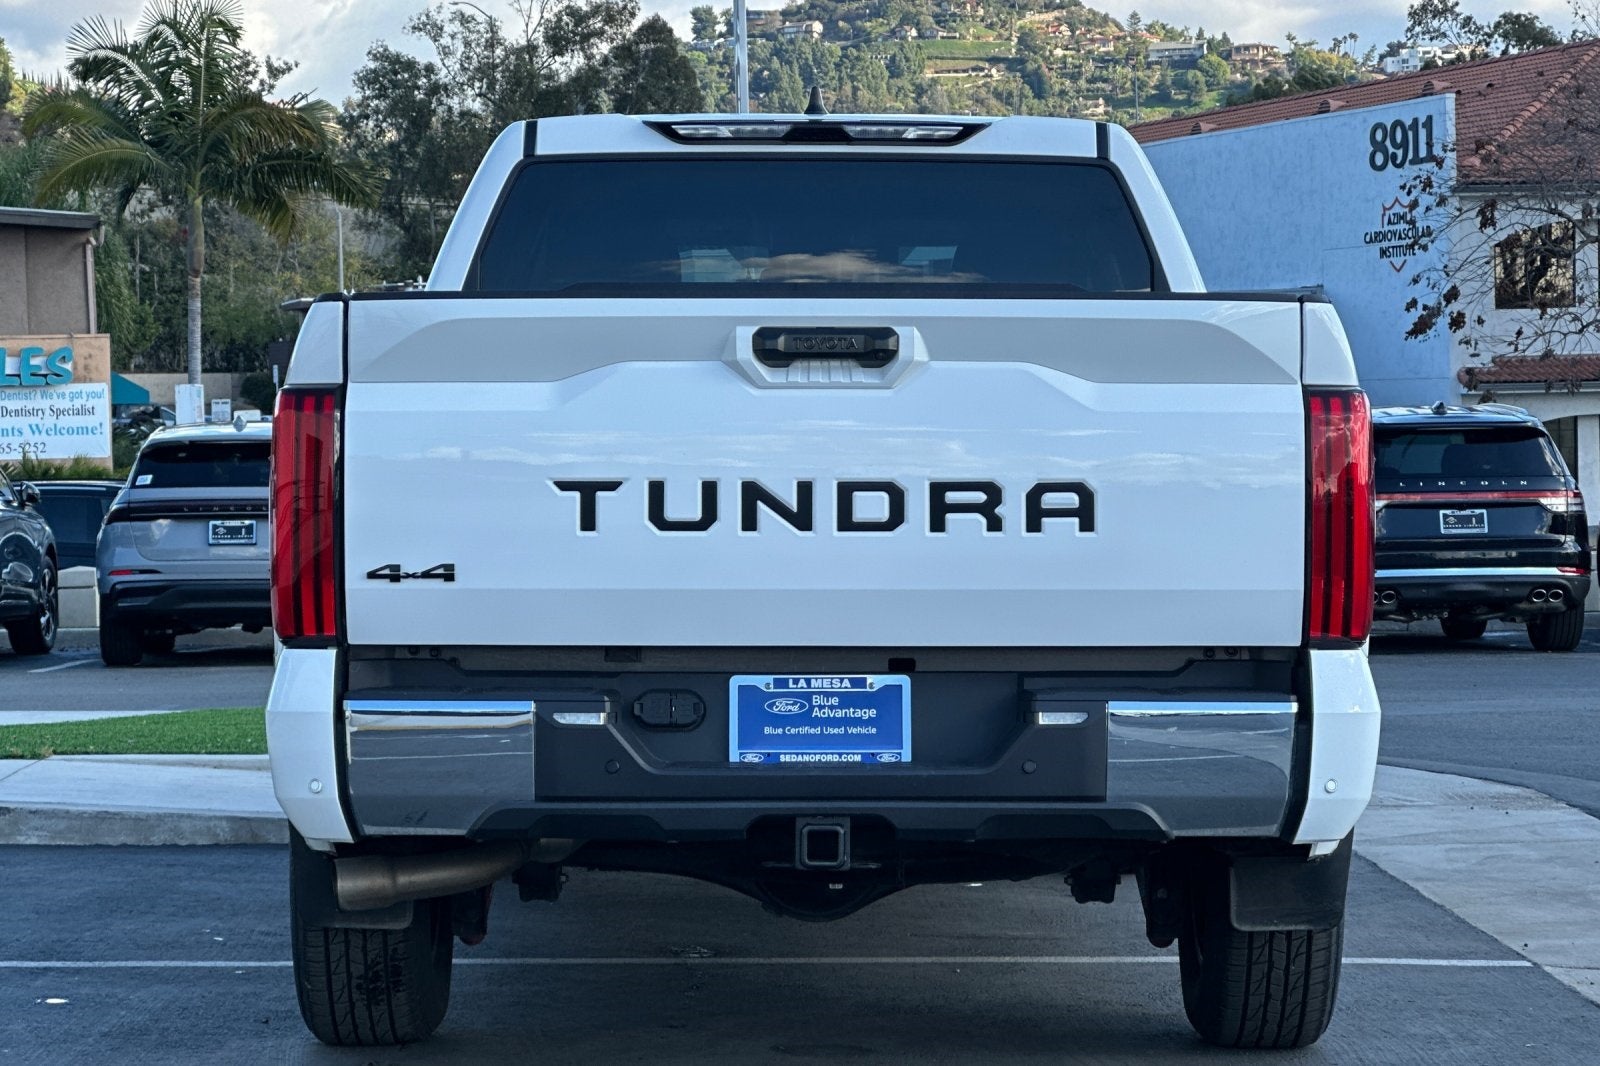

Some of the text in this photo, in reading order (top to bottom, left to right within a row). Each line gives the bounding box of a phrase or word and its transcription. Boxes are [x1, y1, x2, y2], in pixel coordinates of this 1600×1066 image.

[1369, 114, 1434, 172] 8911
[793, 336, 858, 350] TOYOTA
[0, 346, 74, 386] LES
[0, 388, 105, 401] Dentist? We've got you!
[1, 404, 96, 420] Dentistry Specialist
[28, 422, 103, 437] Welcome!
[551, 479, 1096, 533] TUNDRA
[366, 563, 456, 583] 4x4
[788, 679, 852, 689] LA MESA
[771, 695, 839, 712] Ford Blue
[811, 707, 877, 719] Advantage
[764, 726, 877, 734] Blue Certified Used Vehicle
[780, 754, 862, 762] SEDANOFORD.COM
